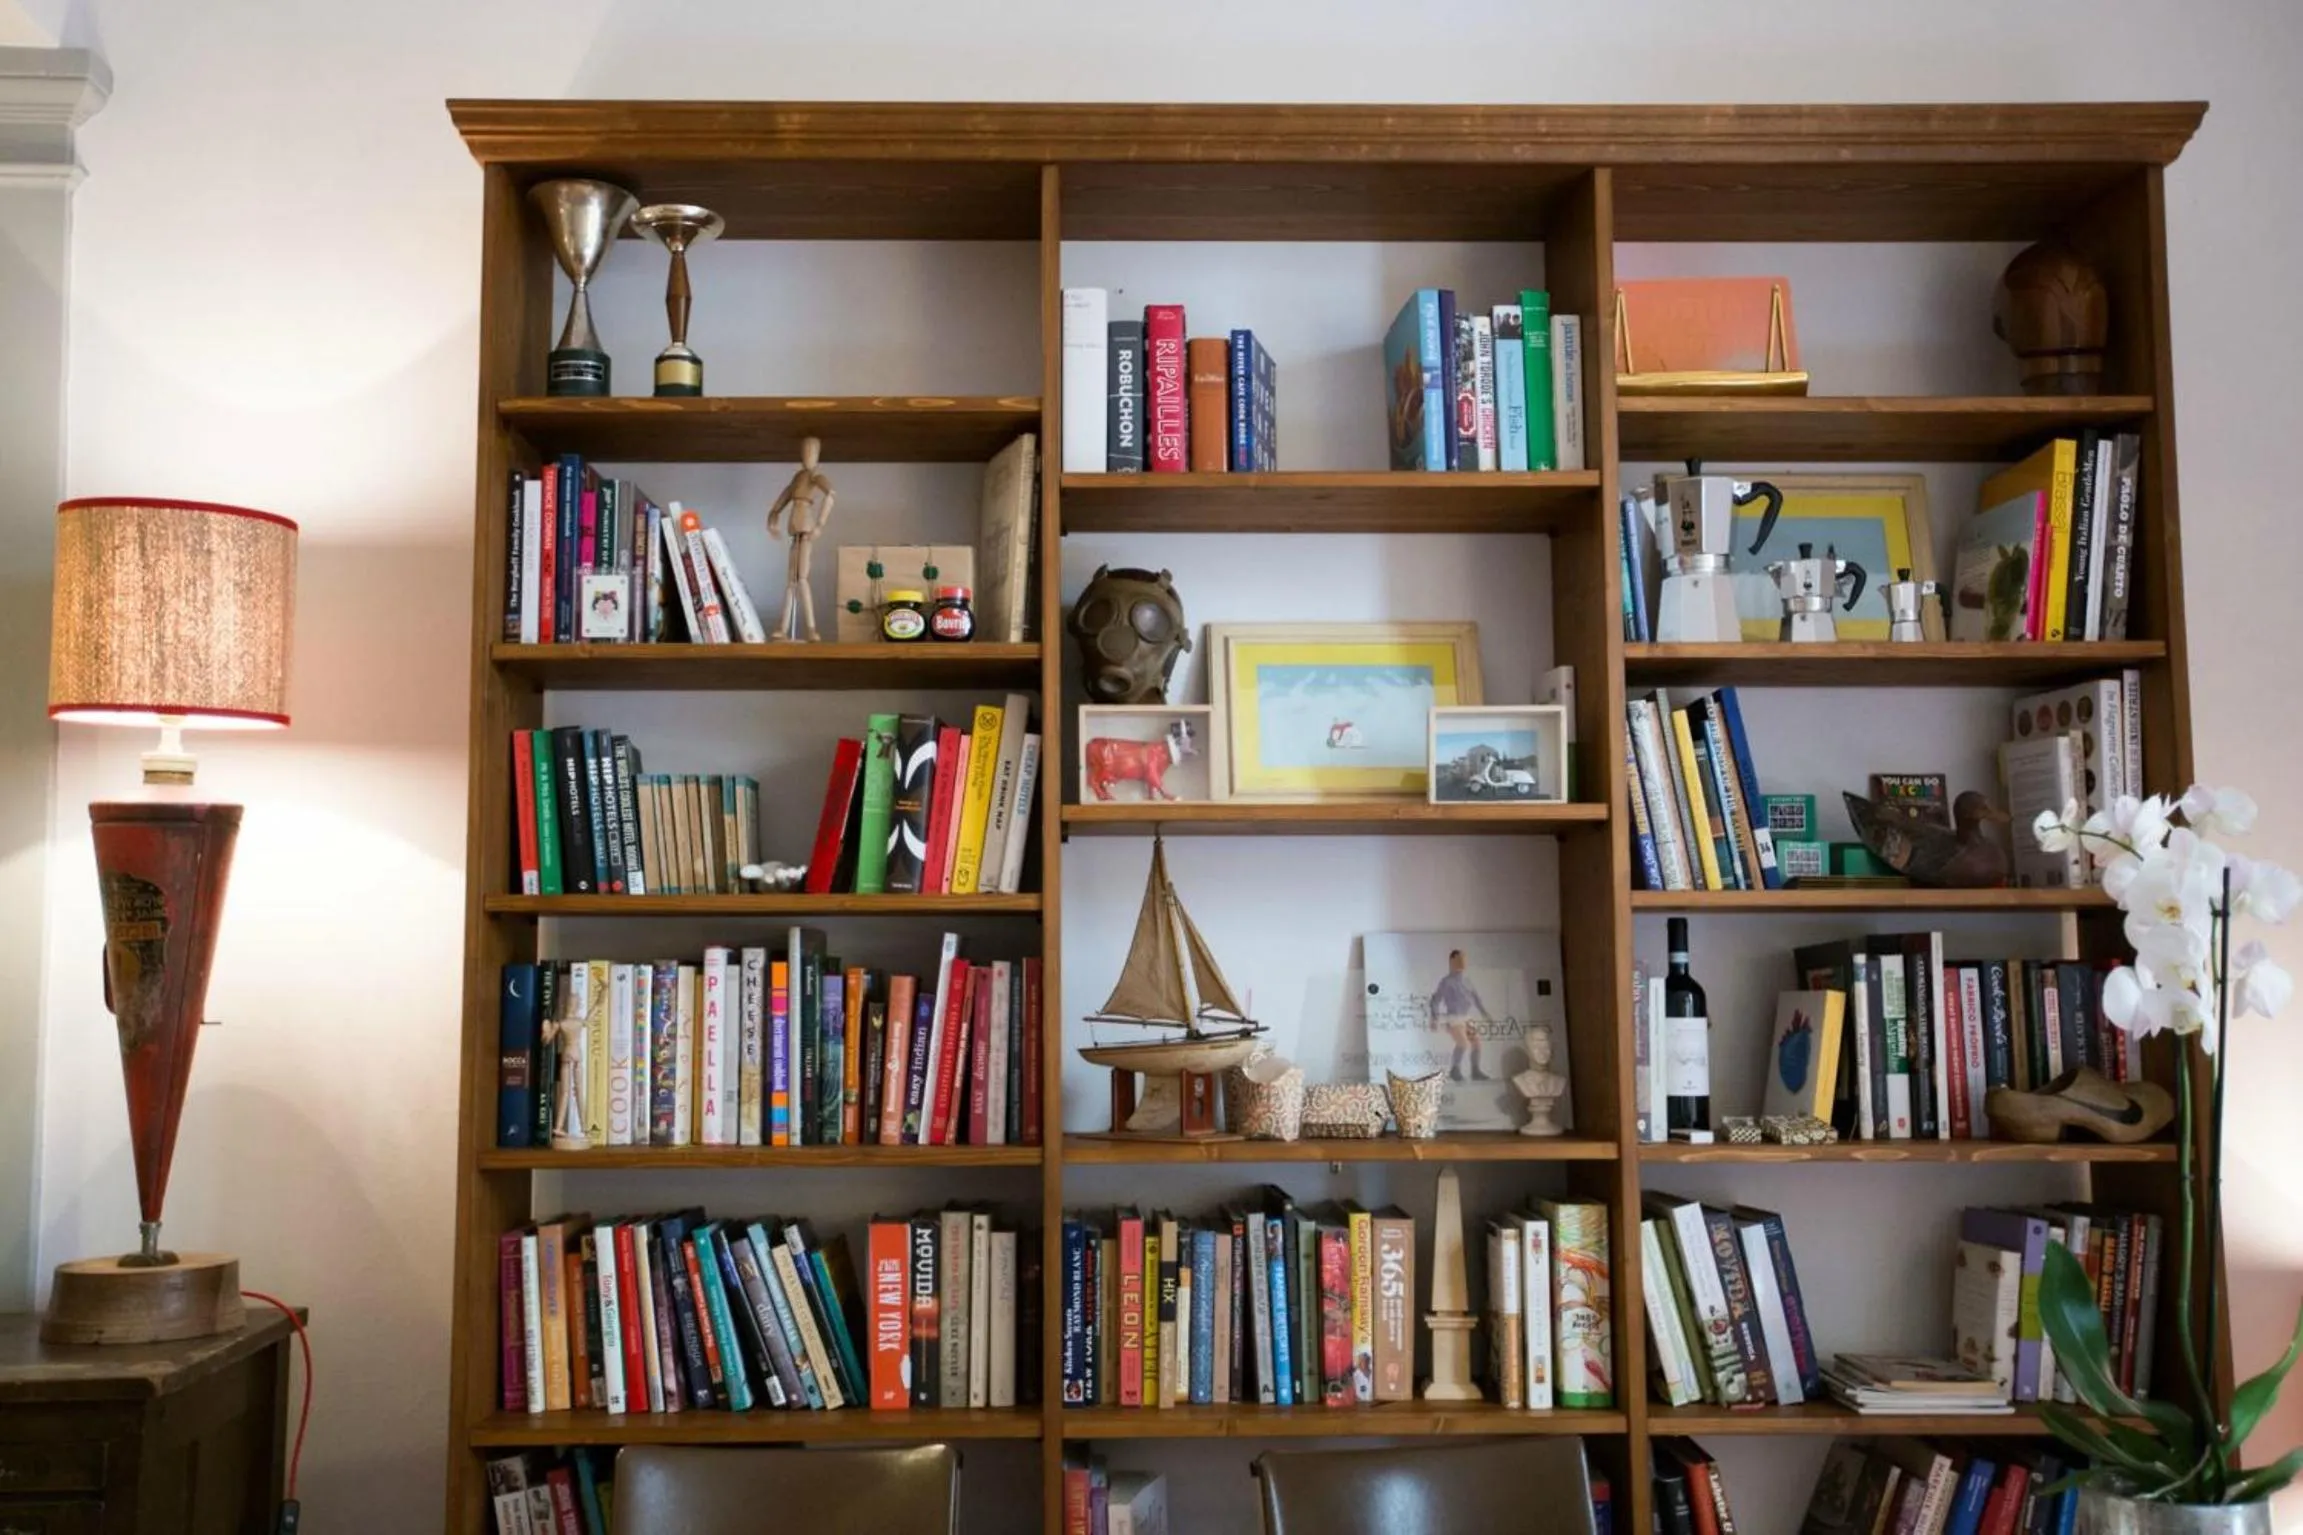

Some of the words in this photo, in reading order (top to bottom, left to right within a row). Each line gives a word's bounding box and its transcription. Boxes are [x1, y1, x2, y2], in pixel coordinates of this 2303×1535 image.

[1479, 331, 1490, 357] JOHN
[1118, 349, 1134, 448] ROBUCHON
[1155, 338, 1181, 462] RIPAILLES
[2118, 476, 2132, 521] PAOLO
[2077, 510, 2090, 547] Italian
[2117, 525, 2127, 543] DE
[2075, 549, 2087, 582] Young
[510, 592, 518, 608] The
[566, 757, 576, 780] HIP
[587, 757, 599, 785] HIP
[601, 756, 613, 785] HIP
[1002, 760, 1012, 777] EAT
[568, 780, 580, 816] HOTELS
[590, 785, 604, 830] HOTELS
[604, 785, 618, 830] HOTELS
[747, 960, 757, 1056] CHEESE
[704, 975, 718, 1116] PAELLA
[912, 1026, 928, 1071] indian
[609, 1056, 628, 1135] COOK
[909, 1073, 924, 1105] easy
[974, 1089, 983, 1115] BAKE
[1072, 1247, 1082, 1282] BLANC
[1356, 1219, 1371, 1273] Gordon
[878, 1272, 903, 1306] NEW
[1380, 1243, 1404, 1298] 365
[1072, 1282, 1082, 1333] RAYMOND
[1162, 1277, 1177, 1304] HIX
[756, 1301, 779, 1338] dairy
[1065, 1307, 1073, 1340] Secrets
[1122, 1273, 1139, 1349] LEON
[1357, 1275, 1372, 1344] Ramsay's
[878, 1311, 903, 1352] YORK
[1064, 1340, 1073, 1375] Kitchen
